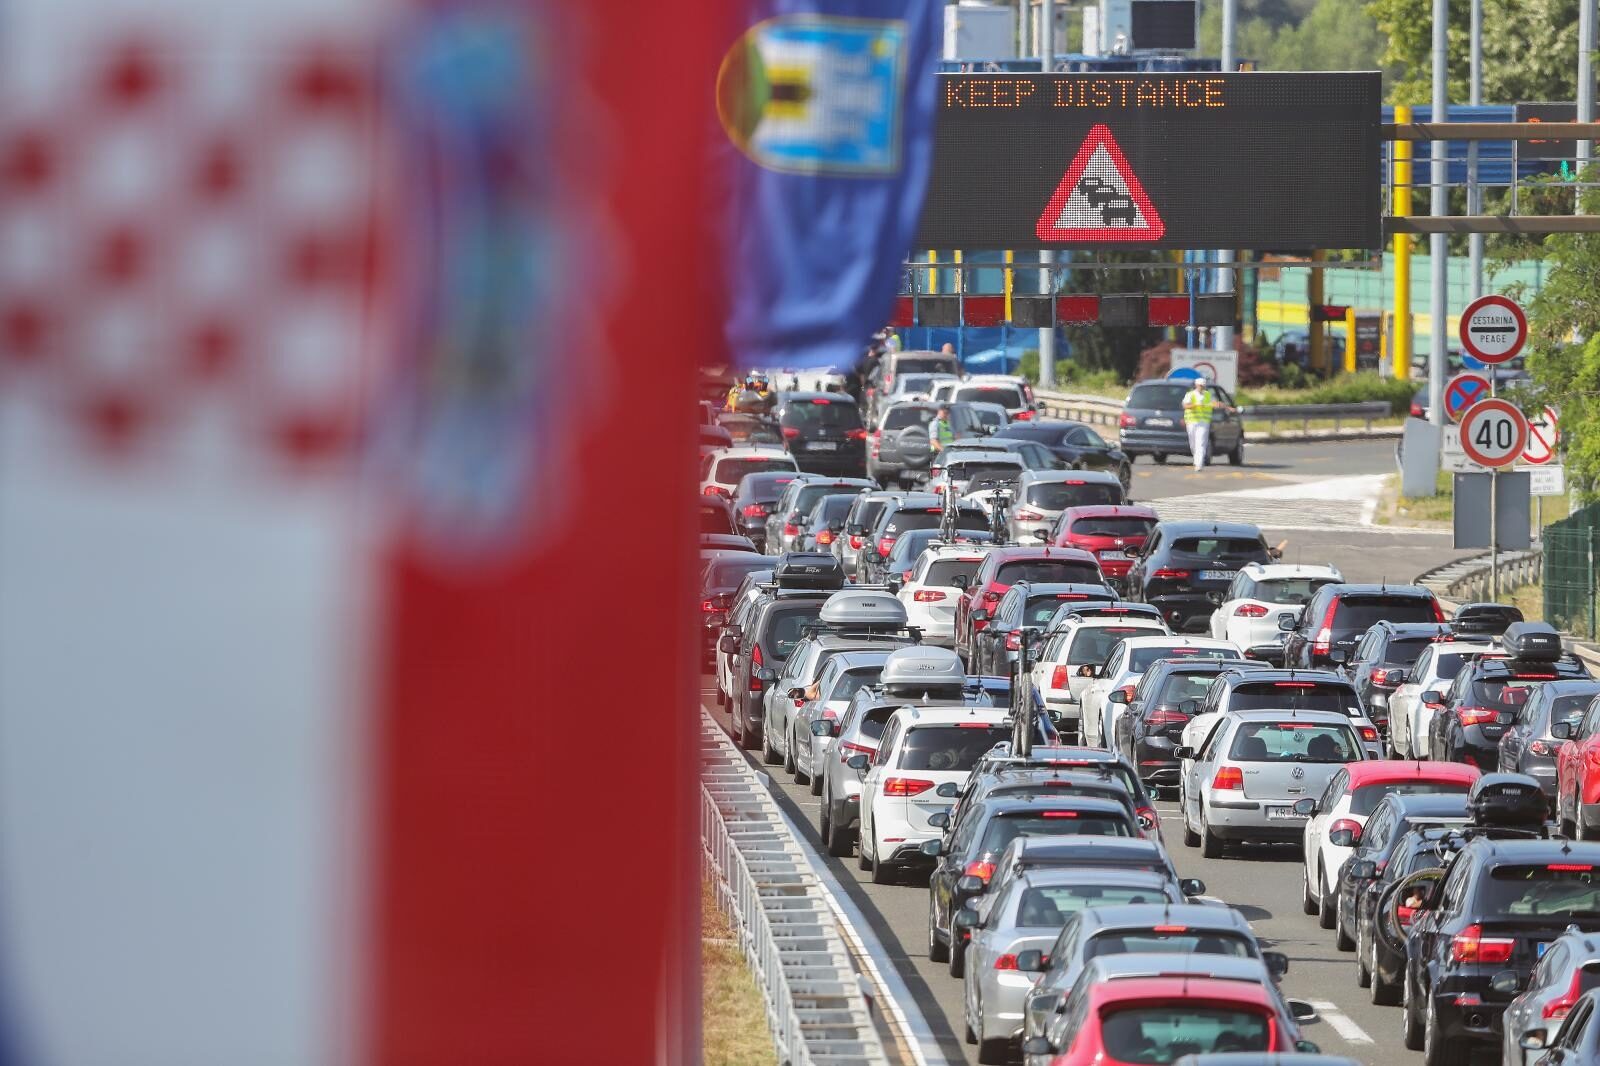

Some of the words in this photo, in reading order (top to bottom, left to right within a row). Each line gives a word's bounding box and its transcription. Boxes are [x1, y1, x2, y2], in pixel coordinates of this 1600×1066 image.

[947, 80, 1035, 107] KEEP
[1054, 79, 1225, 107] DISTANCE
[1472, 316, 1513, 325] CESTARINA
[1480, 334, 1507, 343] PEAGE
[1475, 419, 1512, 449] 40
